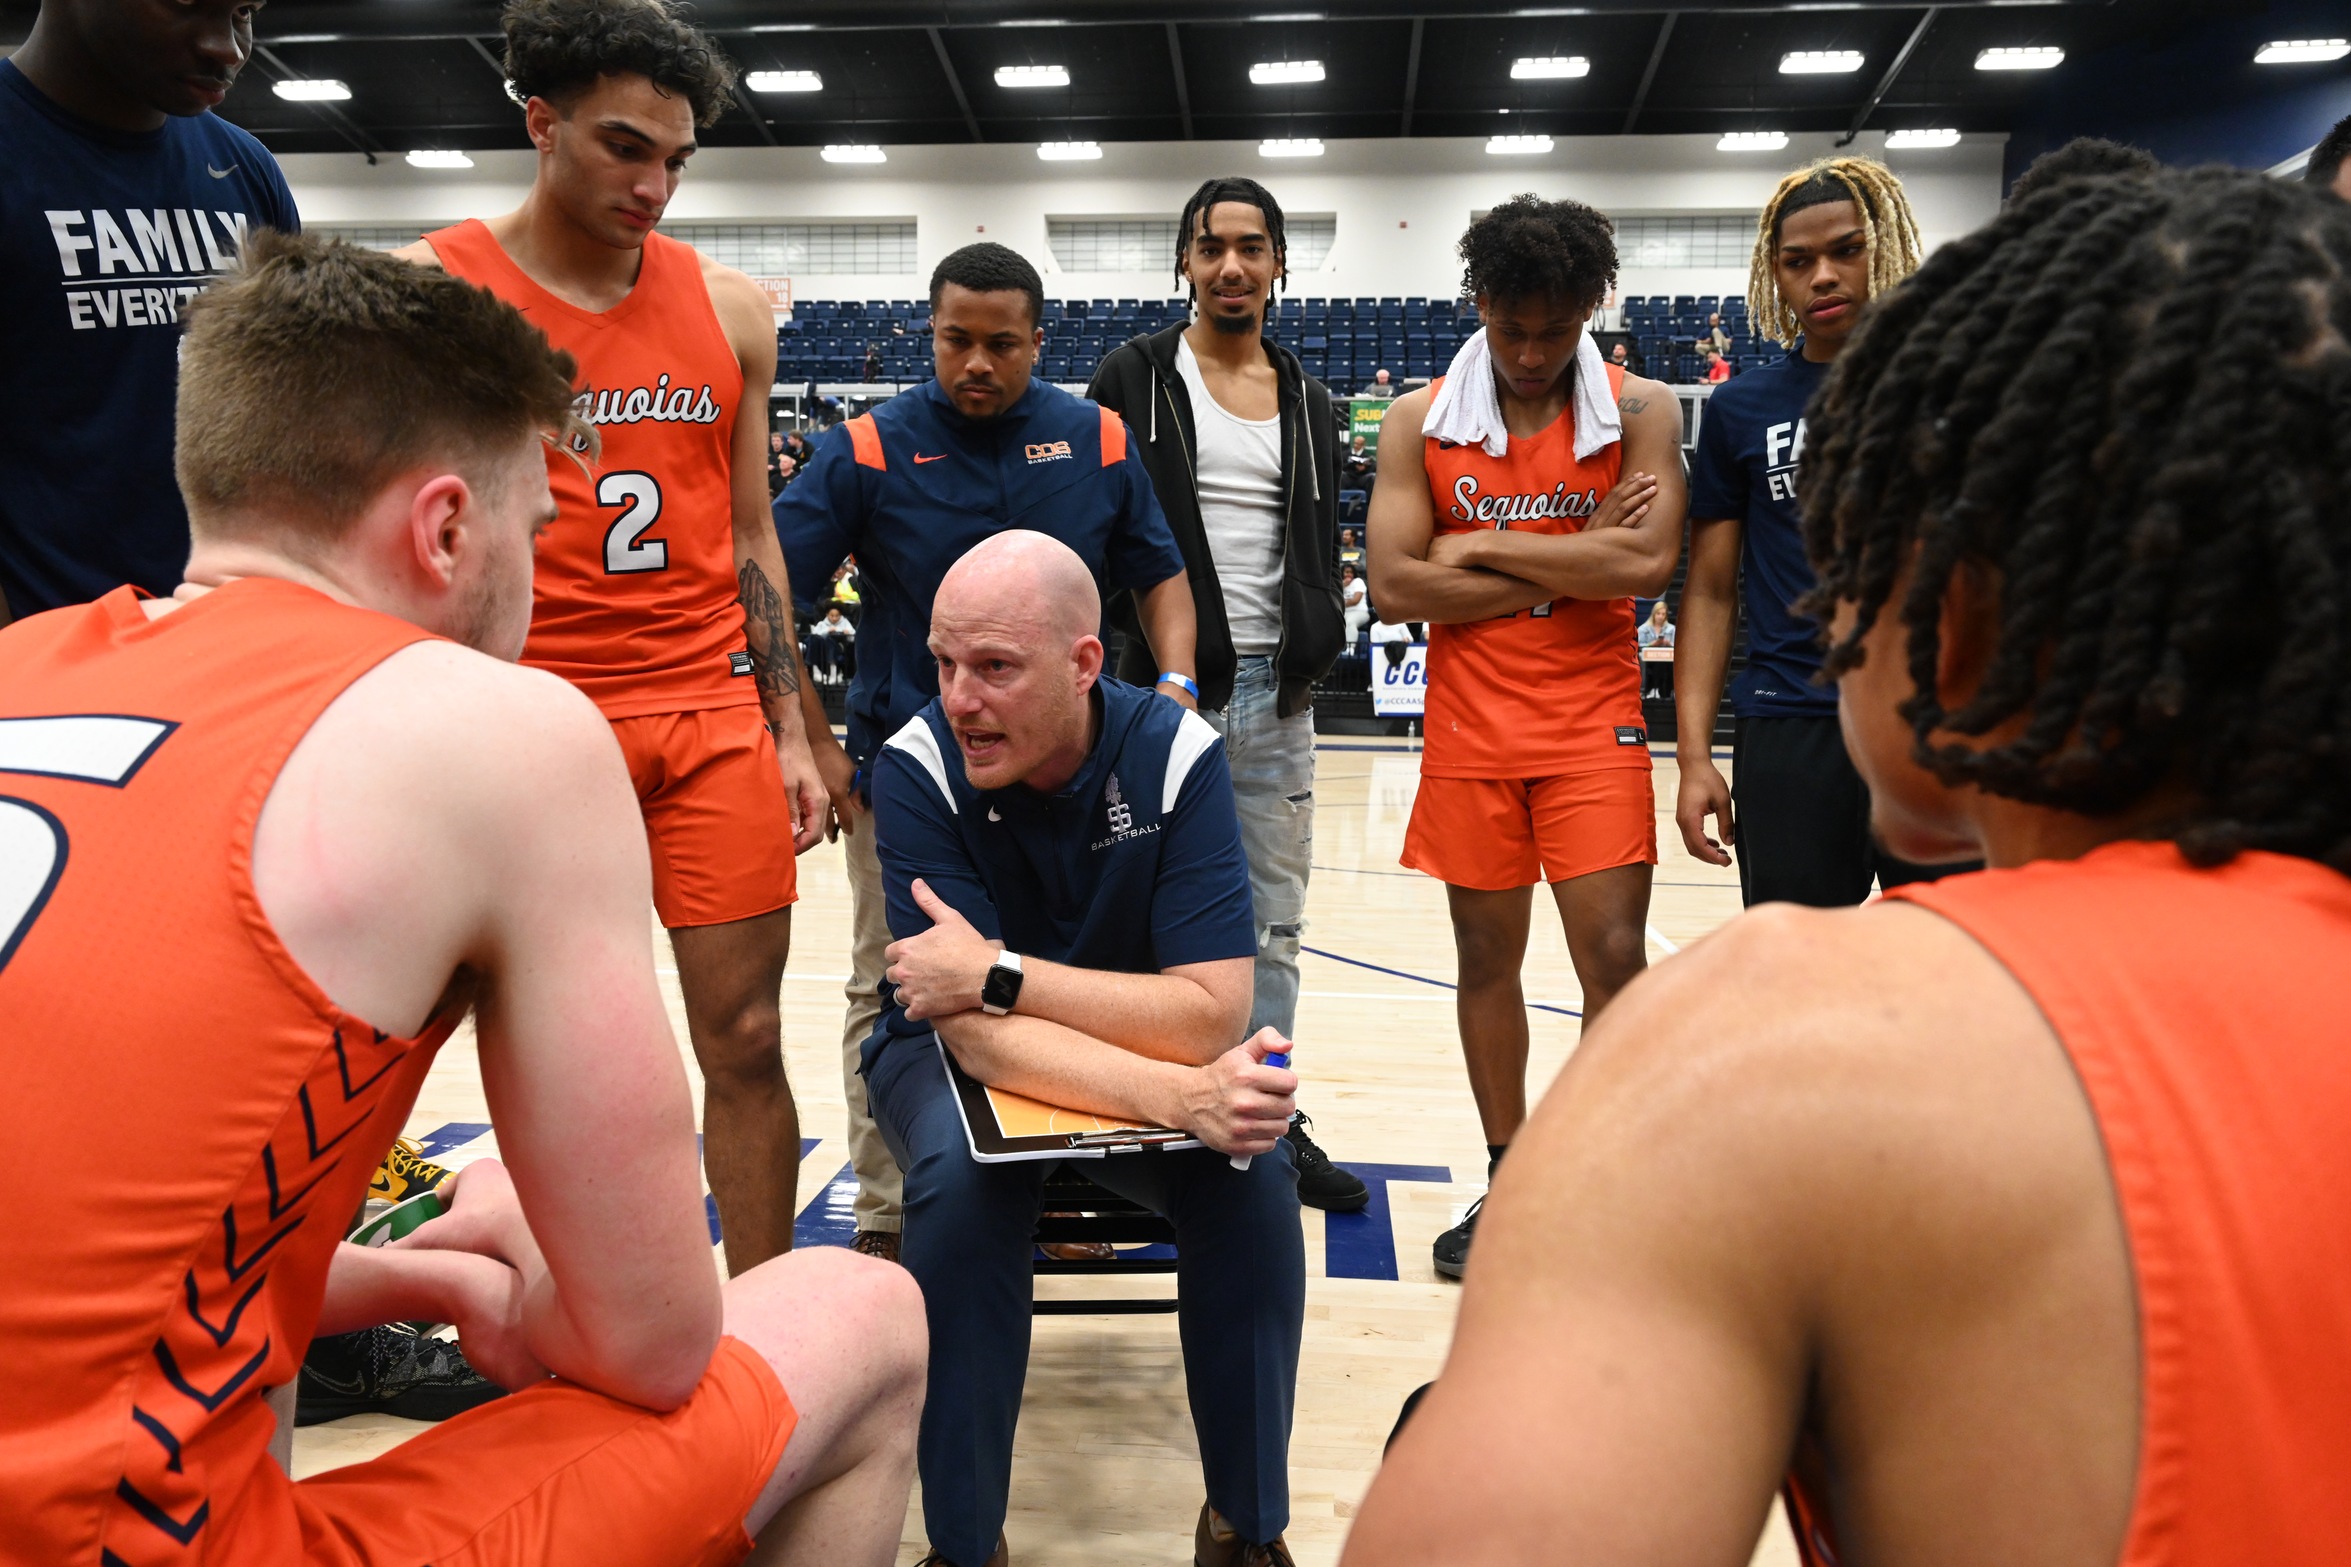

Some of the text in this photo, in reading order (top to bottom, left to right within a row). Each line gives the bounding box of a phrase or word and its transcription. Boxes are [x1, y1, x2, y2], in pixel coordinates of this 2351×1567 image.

[66, 286, 208, 330] EVERYT
[572, 373, 721, 452] quoias
[1025, 441, 1072, 459] COS
[1027, 453, 1073, 465] BASKETBALL
[595, 470, 668, 575] 2
[1451, 475, 1600, 530] Sequoias
[1091, 823, 1162, 851] BASKETBALL
